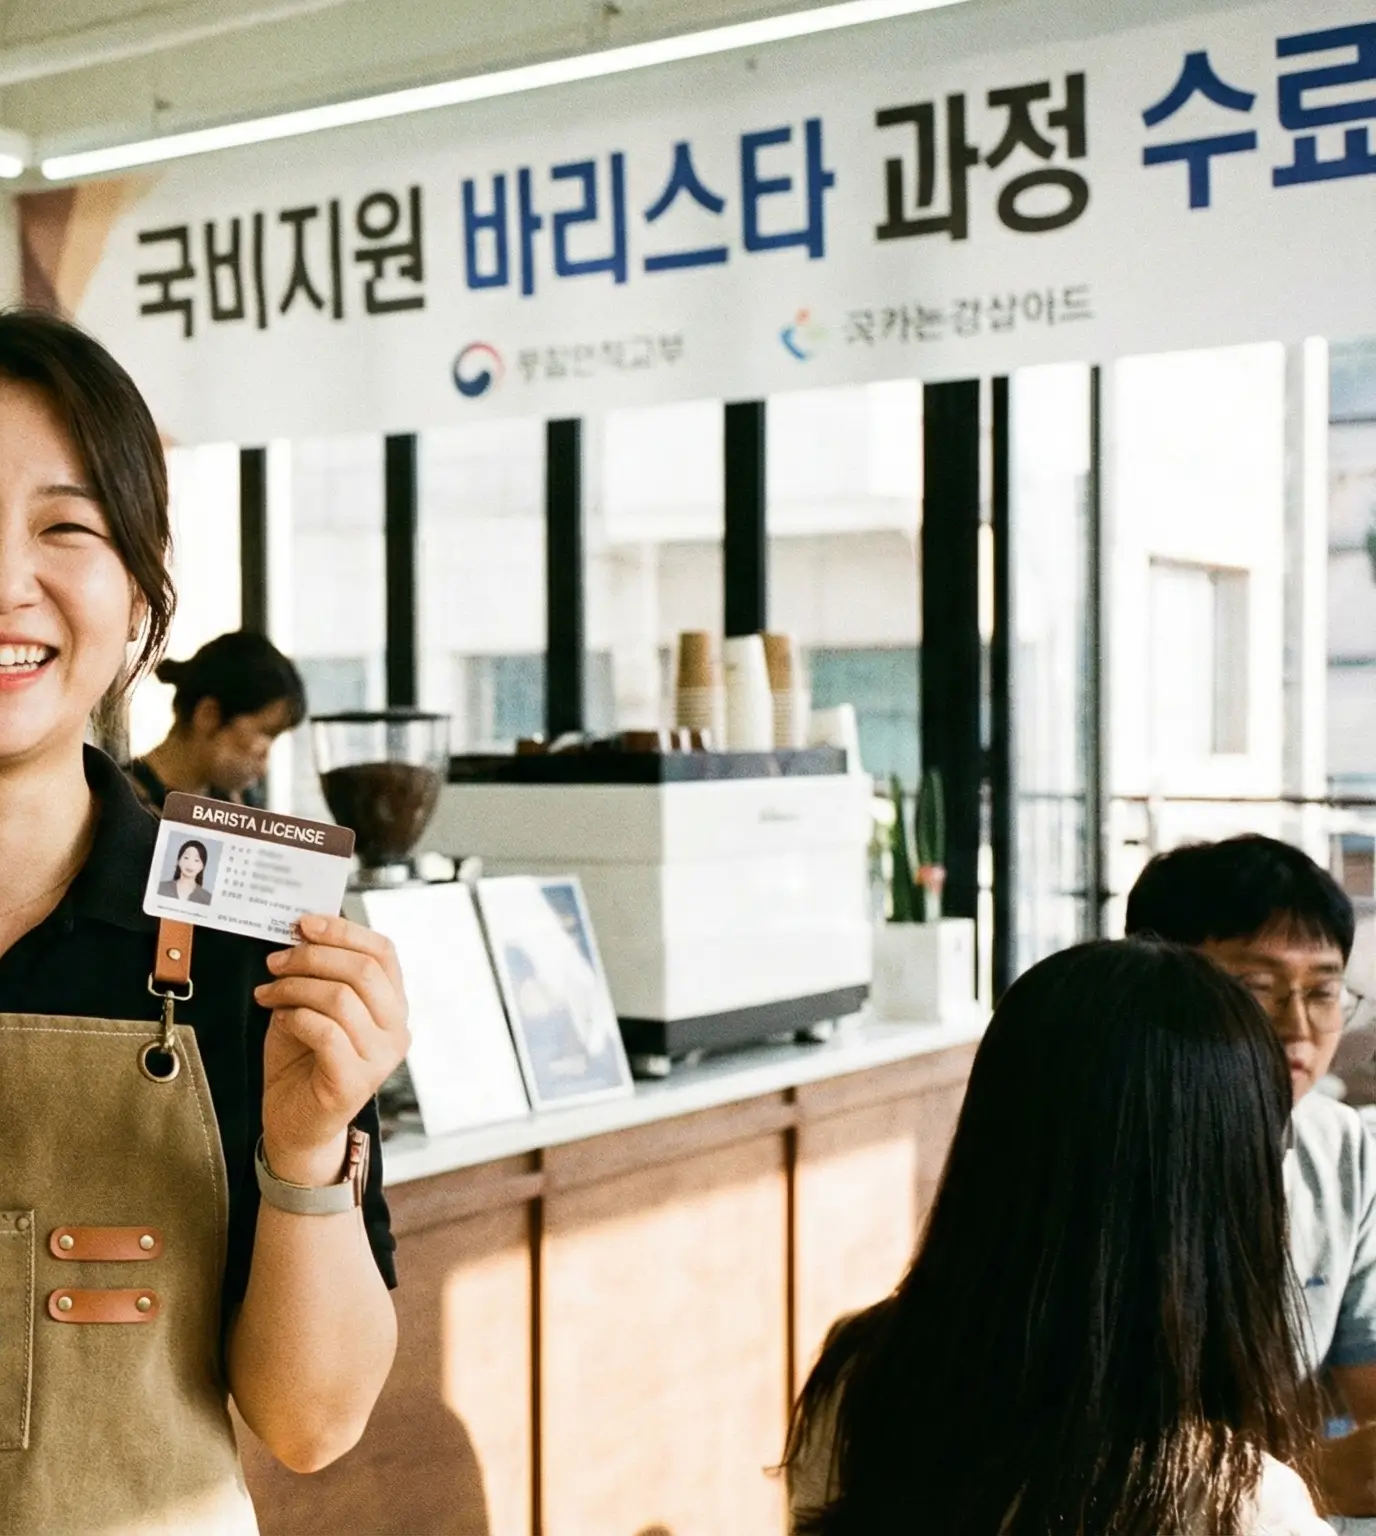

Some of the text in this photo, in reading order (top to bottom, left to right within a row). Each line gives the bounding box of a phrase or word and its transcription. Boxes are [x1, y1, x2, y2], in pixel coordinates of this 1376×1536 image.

[138, 186, 424, 337] 국비지원
[463, 118, 834, 295] 바리스타
[875, 72, 1089, 241] 과정
[192, 804, 326, 846] BARISTA LICENSE
